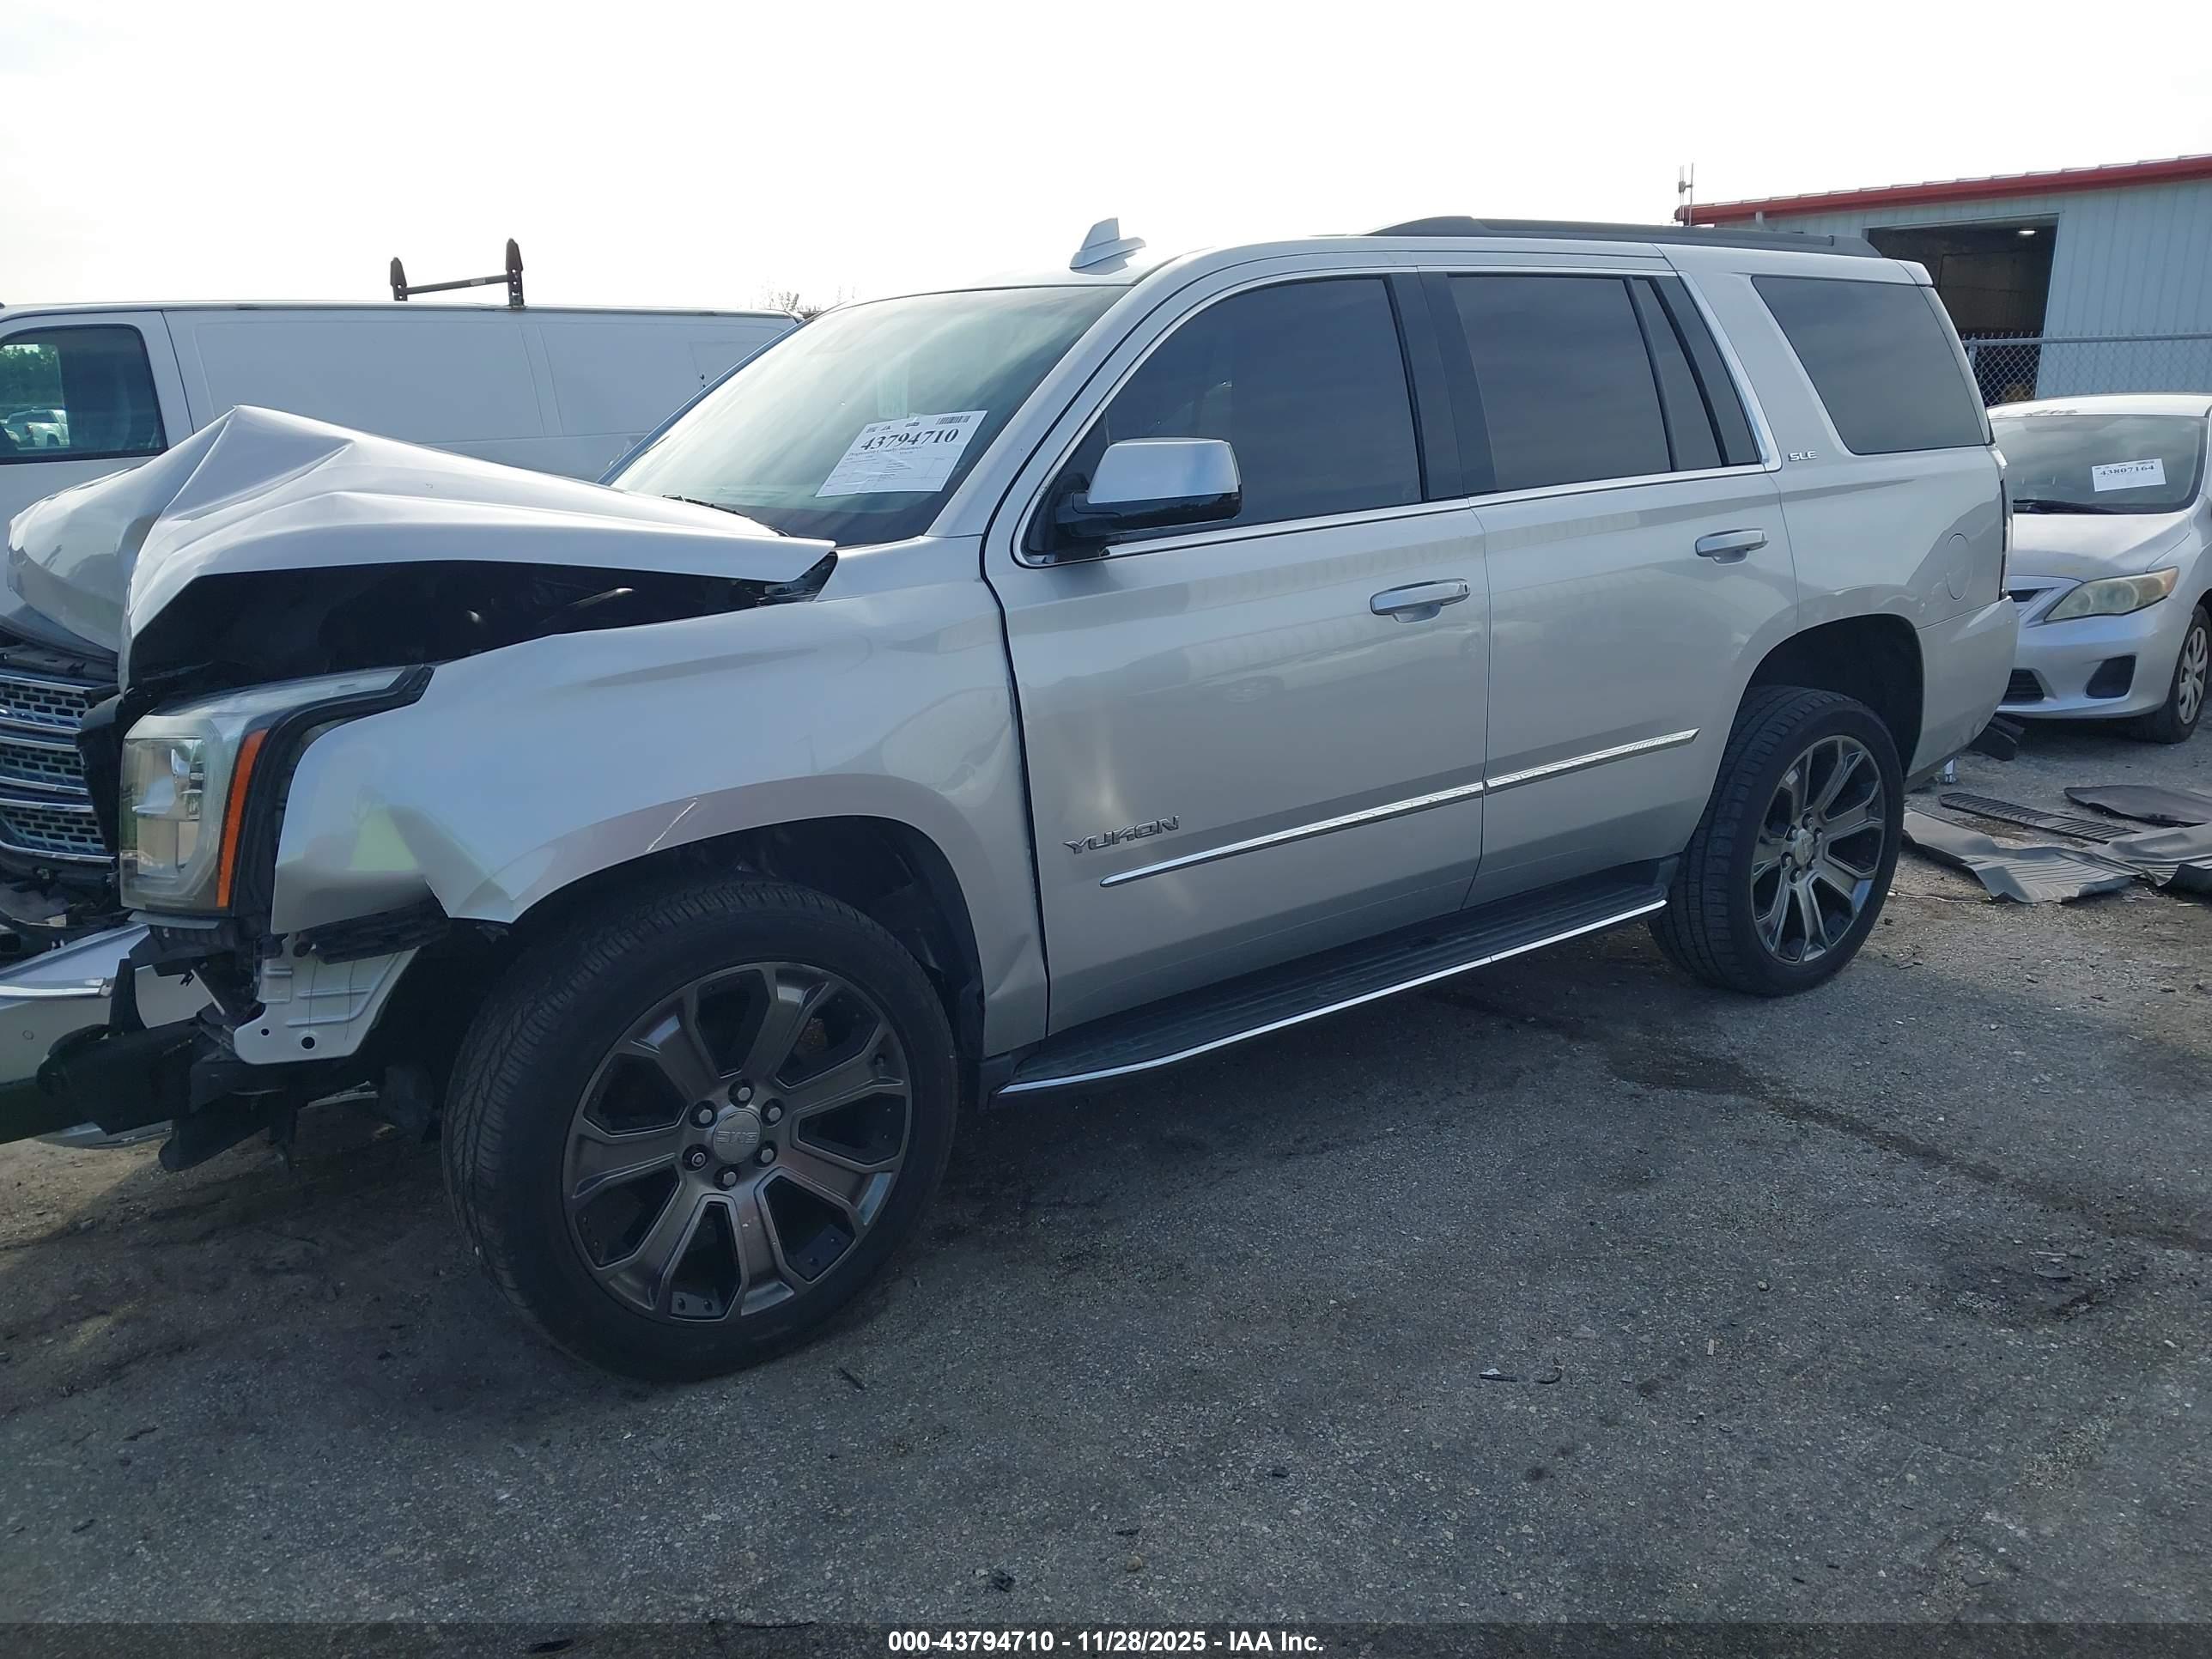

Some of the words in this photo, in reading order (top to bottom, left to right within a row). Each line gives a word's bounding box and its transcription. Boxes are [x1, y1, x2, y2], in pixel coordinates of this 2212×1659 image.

[860, 428, 959, 451] 43794710
[1788, 451, 1818, 461] SLE
[2100, 465, 2154, 476] 43807164
[1063, 816, 1180, 854] YUKON
